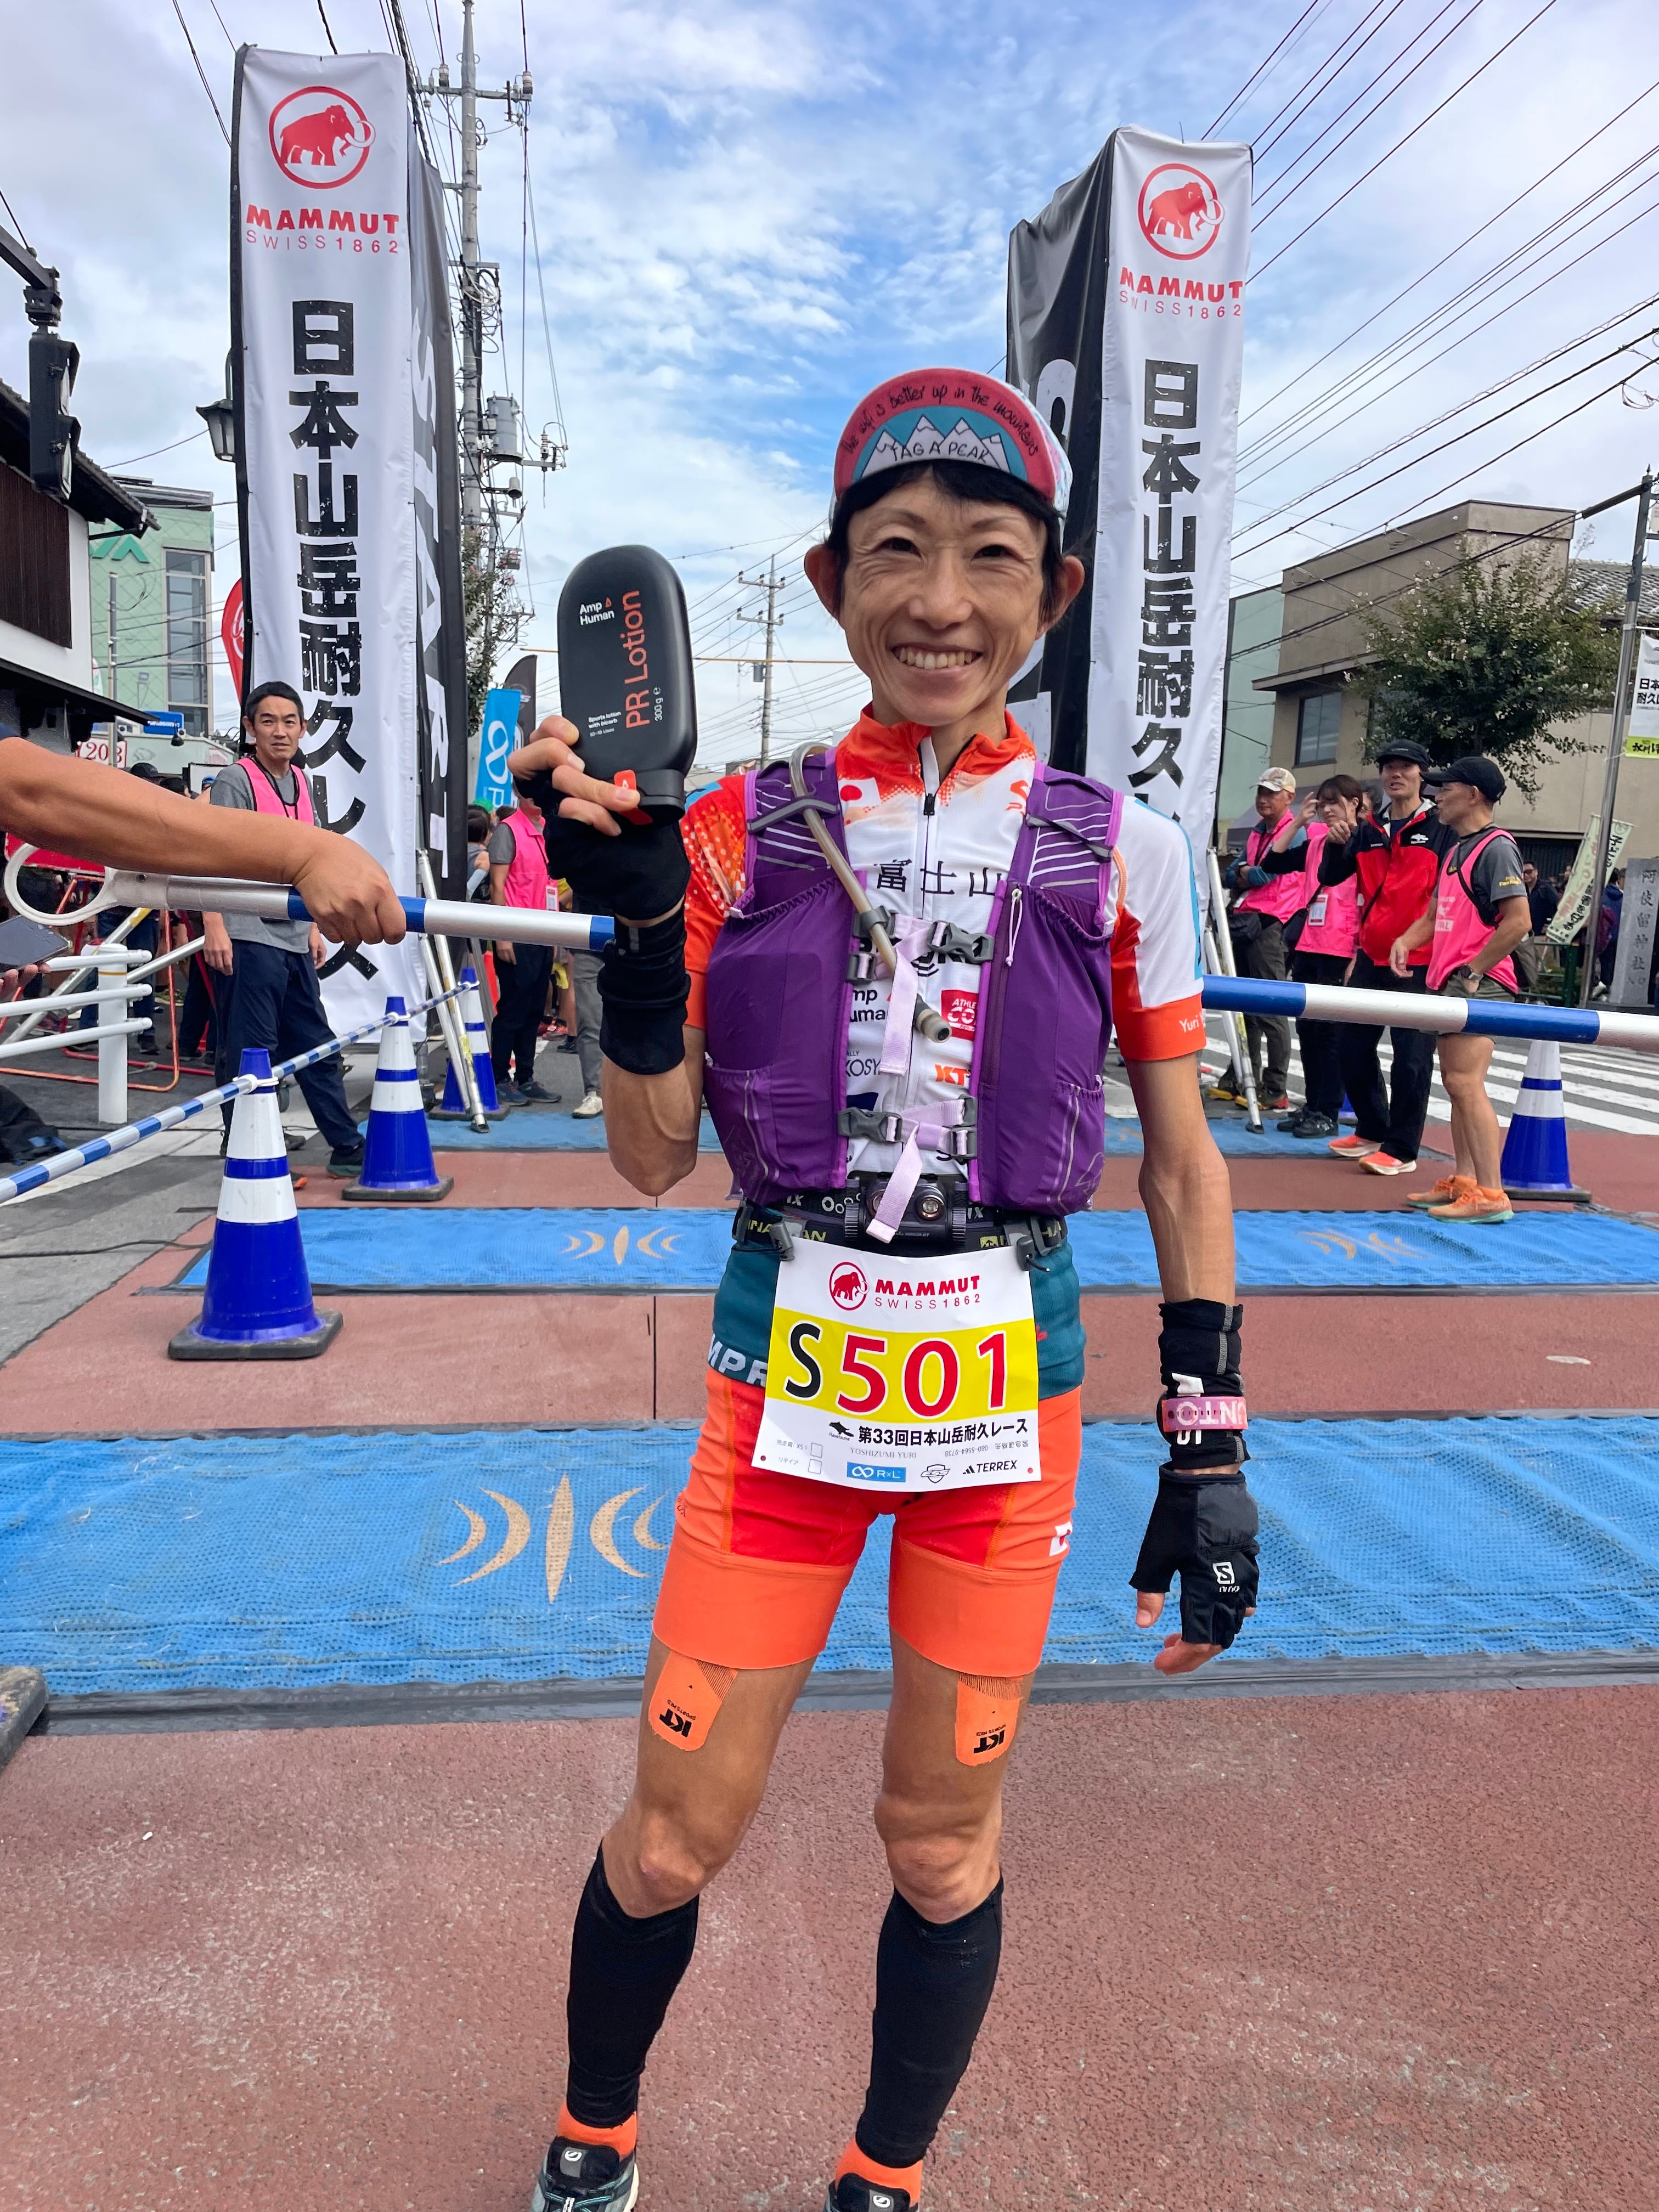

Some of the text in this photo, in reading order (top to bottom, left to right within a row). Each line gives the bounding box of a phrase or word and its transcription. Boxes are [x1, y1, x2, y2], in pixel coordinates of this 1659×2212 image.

[246, 204, 399, 234] MAMMUT
[1120, 267, 1243, 303] MAMMUT
[888, 386, 926, 408] better
[933, 385, 947, 404] up
[954, 387, 965, 398] in
[929, 442, 941, 454] A
[948, 442, 989, 463] PEAK
[579, 601, 603, 615] Amp
[580, 610, 615, 626] Human
[289, 300, 379, 981] 日本山岳耐久レス
[619, 590, 651, 729] PR Lotion
[1637, 692, 1659, 705] 耐久
[874, 858, 1003, 898] 富士山
[851, 989, 878, 1005] mp
[952, 998, 978, 1009] ATHLE
[850, 1008, 888, 1023] uma
[1179, 1015, 1199, 1033] Yuri
[875, 1276, 980, 1296] MAMMUT
[858, 1418, 1028, 1447] 第33回日本山岳耐久レース
[850, 1447, 895, 1459] YOSHIZUMI
[977, 1460, 1018, 1474] TERREX
[659, 1708, 692, 1737] KT
[974, 1729, 1005, 1754] KT
